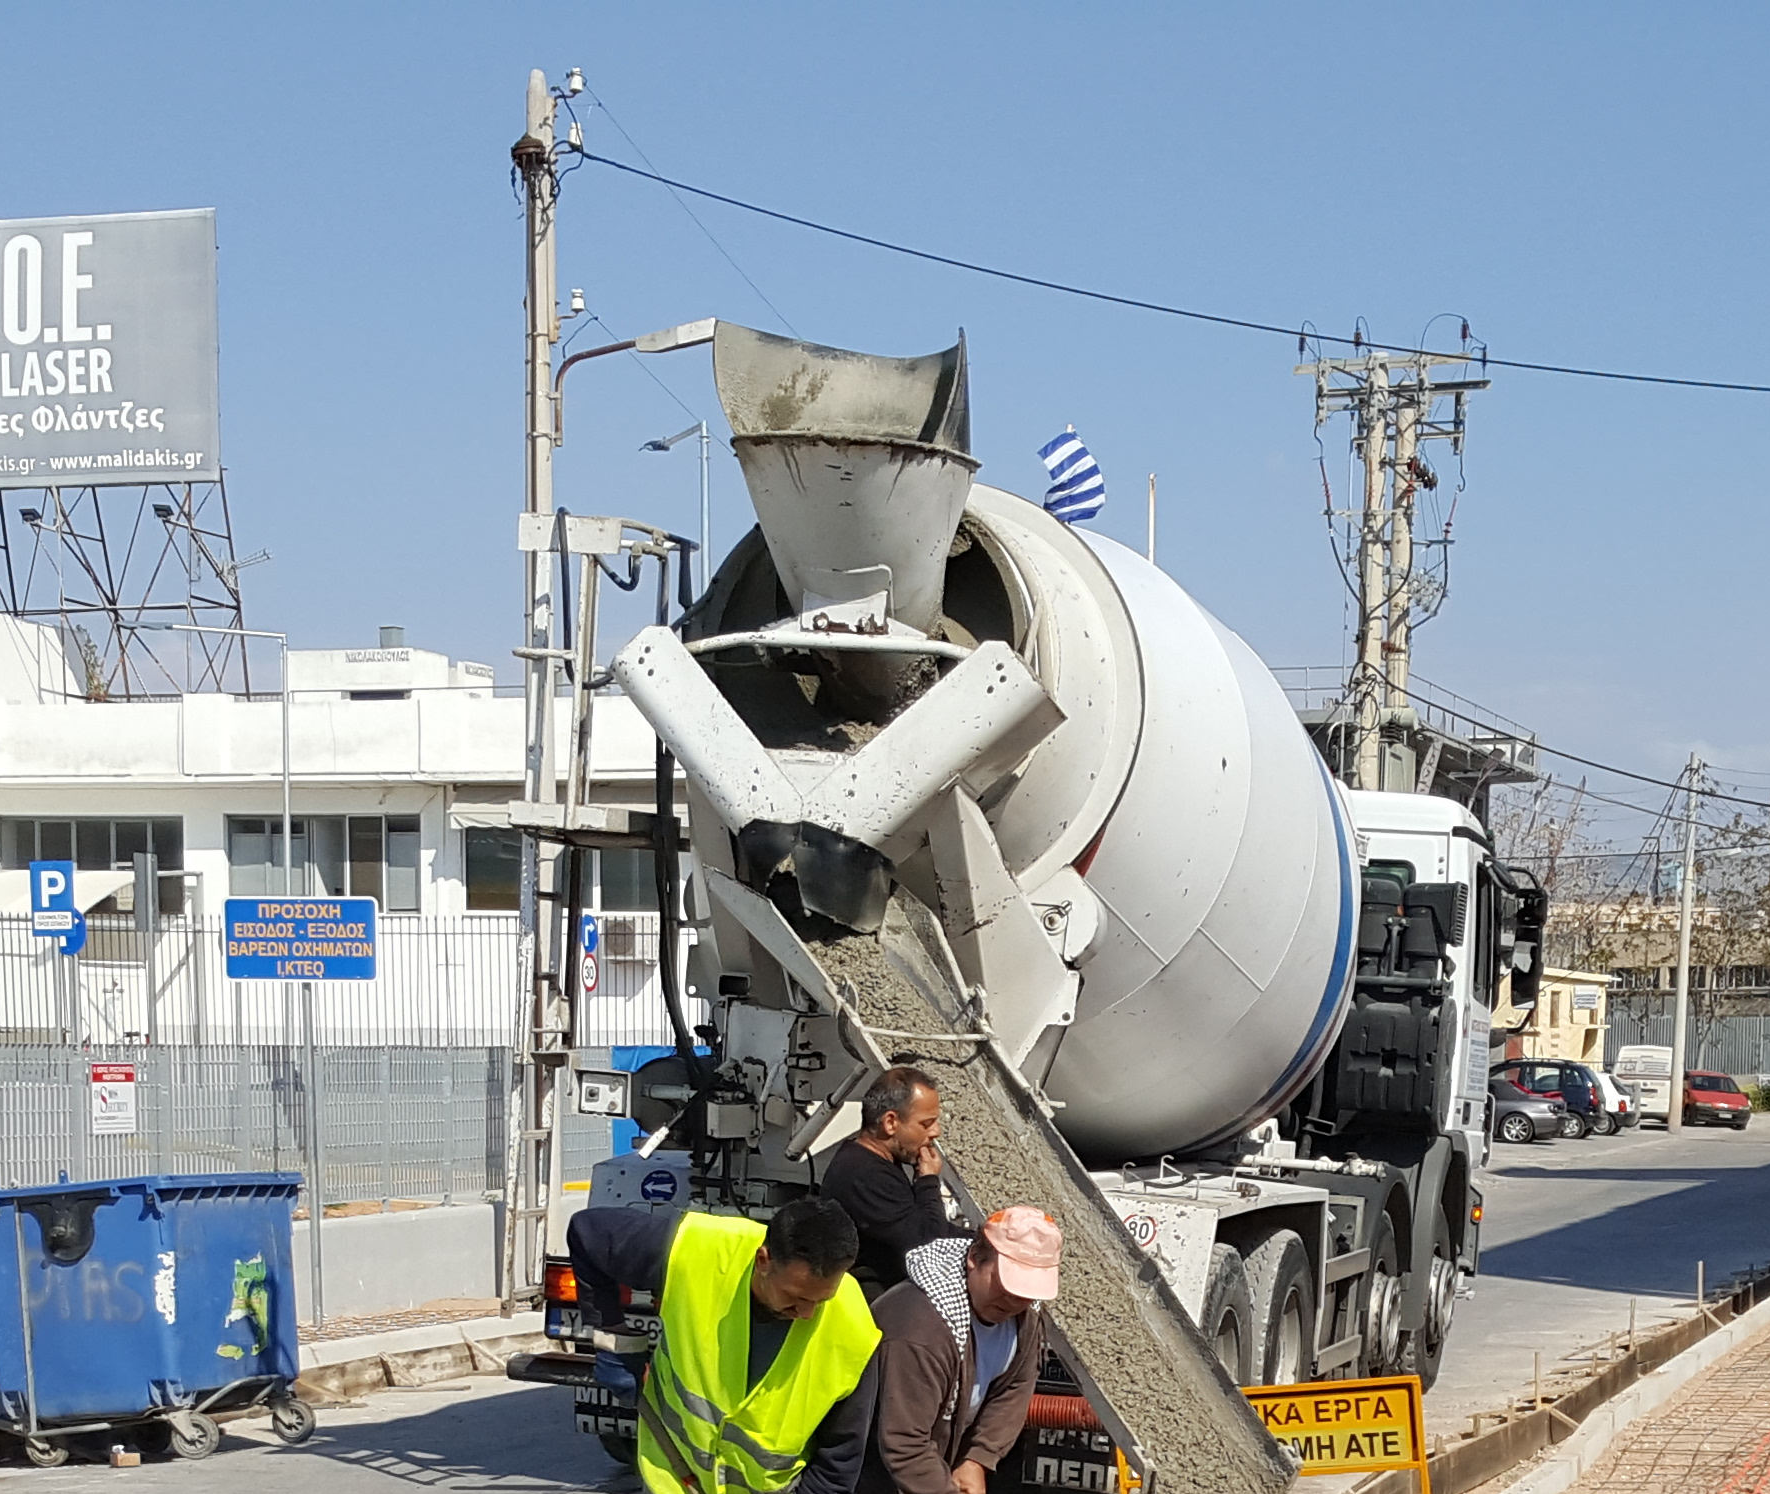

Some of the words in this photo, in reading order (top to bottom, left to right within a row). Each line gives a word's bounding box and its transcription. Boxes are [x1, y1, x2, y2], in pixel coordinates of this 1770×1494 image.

[0, 347, 113, 398] LASER
[31, 401, 165, 433] Φλάντζες
[50, 449, 203, 470] www.malidakis.gr
[41, 871, 66, 907] P
[258, 903, 342, 918] ΠΡΟΣΟΧΗ
[234, 922, 295, 938] ΕΙΣΟΔΟΣ
[307, 923, 366, 938] ΕΞΟΔΟΣ
[229, 941, 288, 956] ΒΑΡΕΩΝ
[292, 942, 374, 957] ΟΧΗΜΑΤΩΝ
[1314, 1396, 1393, 1423] ΕΡΓΑ
[1345, 1431, 1401, 1459] ΑΤΕ
